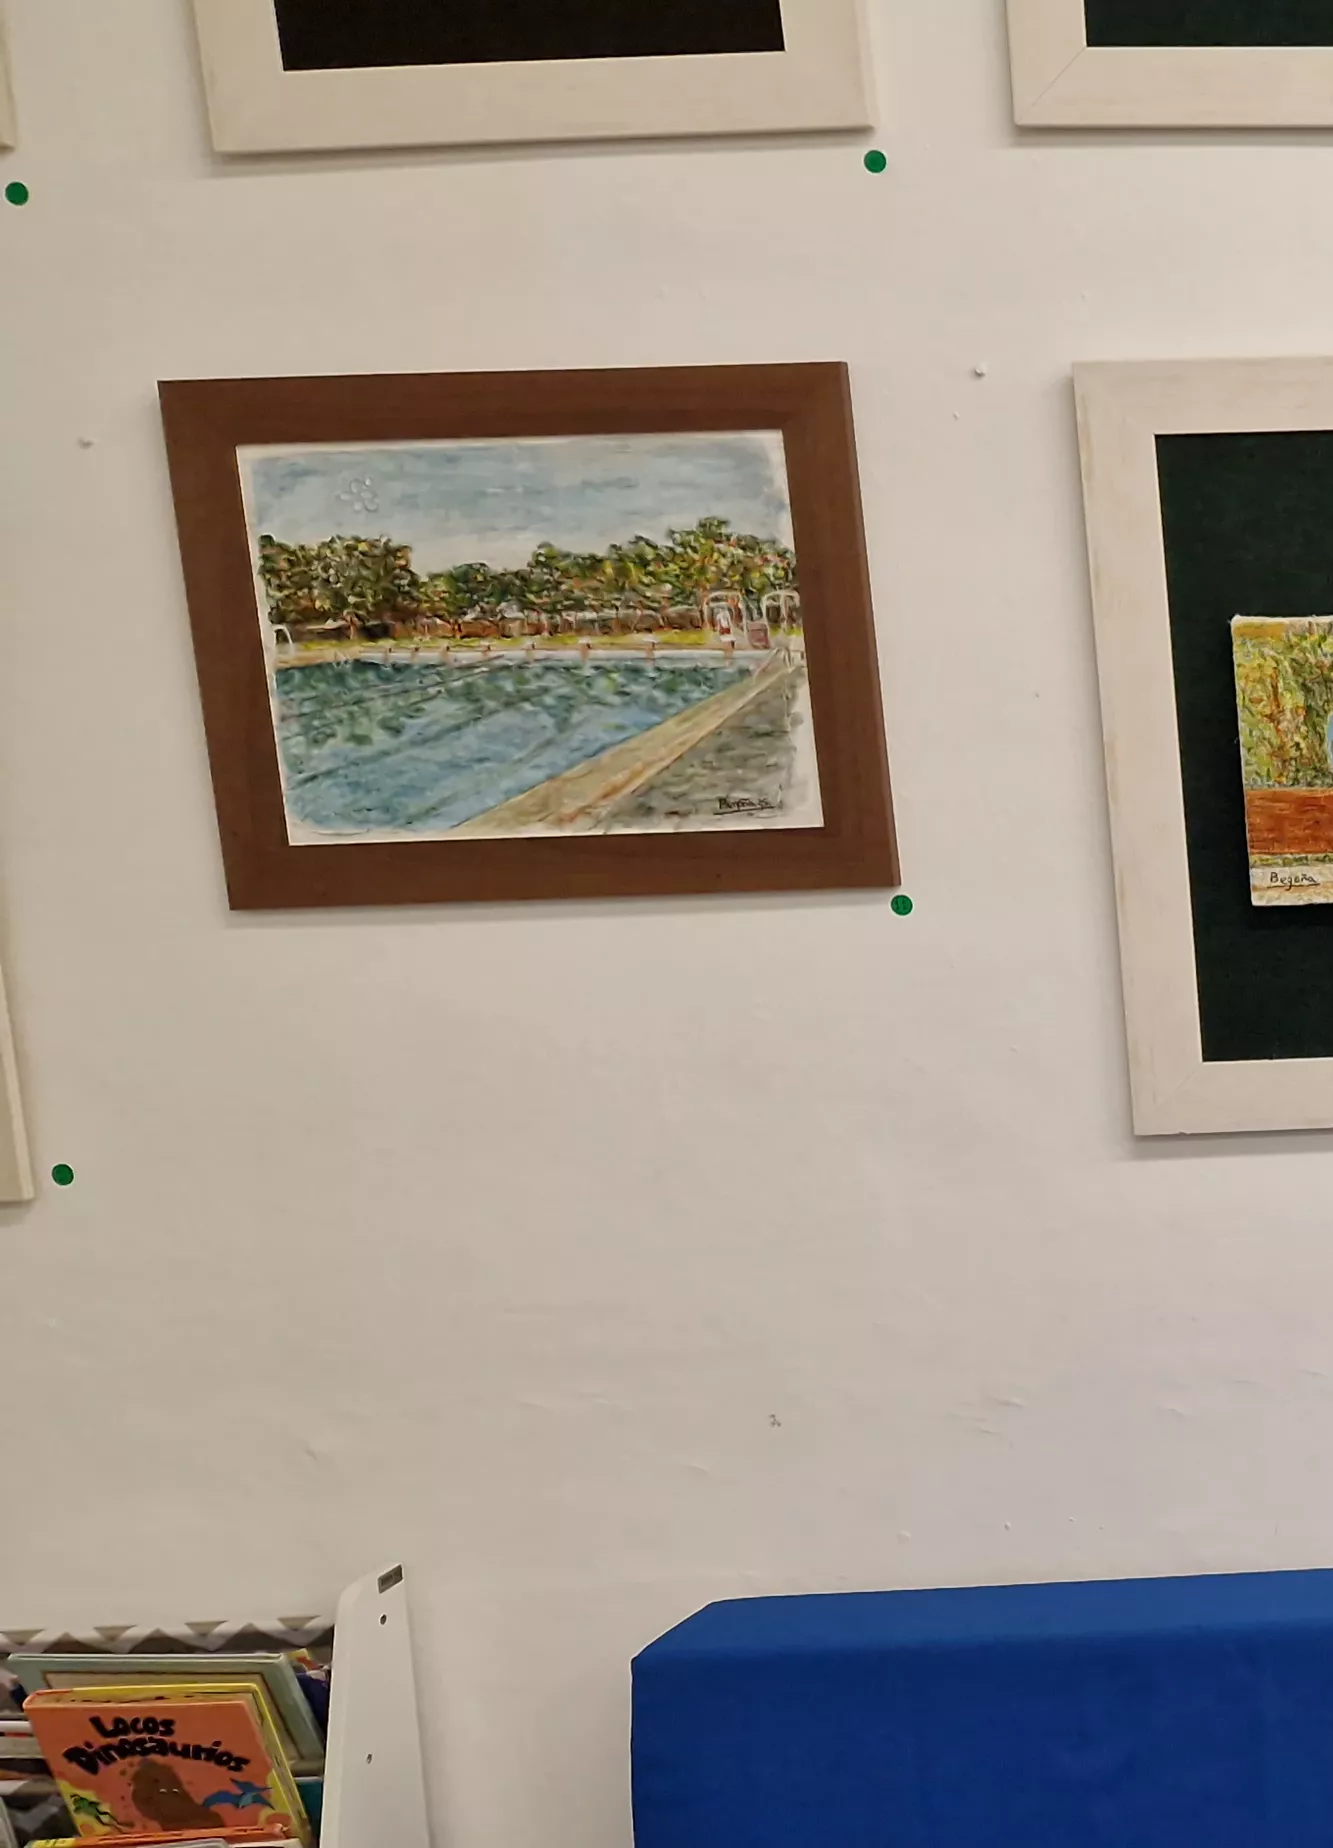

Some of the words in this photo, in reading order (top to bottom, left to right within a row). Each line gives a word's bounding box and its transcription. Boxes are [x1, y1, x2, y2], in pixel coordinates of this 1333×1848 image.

[1269, 871, 1318, 891] Begoña
[89, 1716, 176, 1738] Locos
[62, 1736, 251, 1776] Dinosaurios
